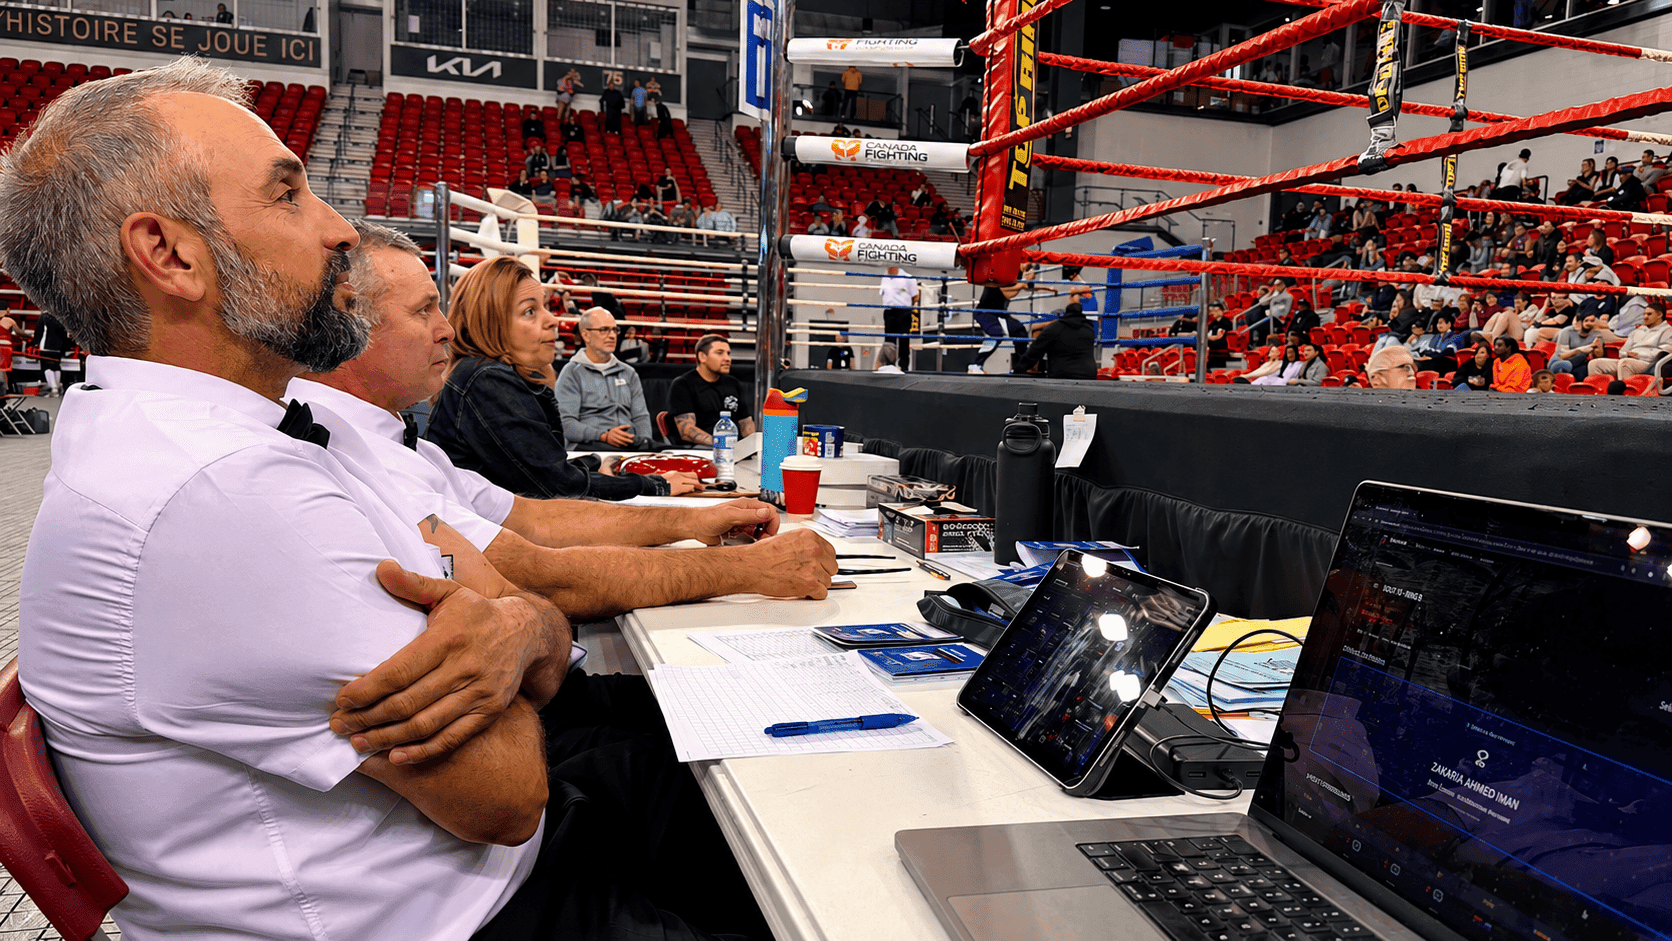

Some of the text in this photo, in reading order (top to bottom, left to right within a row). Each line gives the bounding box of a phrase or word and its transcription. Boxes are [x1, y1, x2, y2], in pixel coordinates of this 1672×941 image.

[152, 25, 185, 49] SE
[198, 30, 268, 57] JOUE
[281, 38, 314, 61] ICI
[1019, 0, 1036, 91] RIN
[427, 54, 502, 79] KIA
[603, 70, 623, 85] 75
[865, 141, 917, 151] CANADA
[865, 149, 928, 162] FIGHTING
[858, 242, 907, 252] CANADA
[857, 250, 917, 262] FIGHTING
[1430, 761, 1463, 785] ZAKARIA
[1464, 778, 1496, 799] AHMED
[1495, 792, 1520, 811] IMAN
